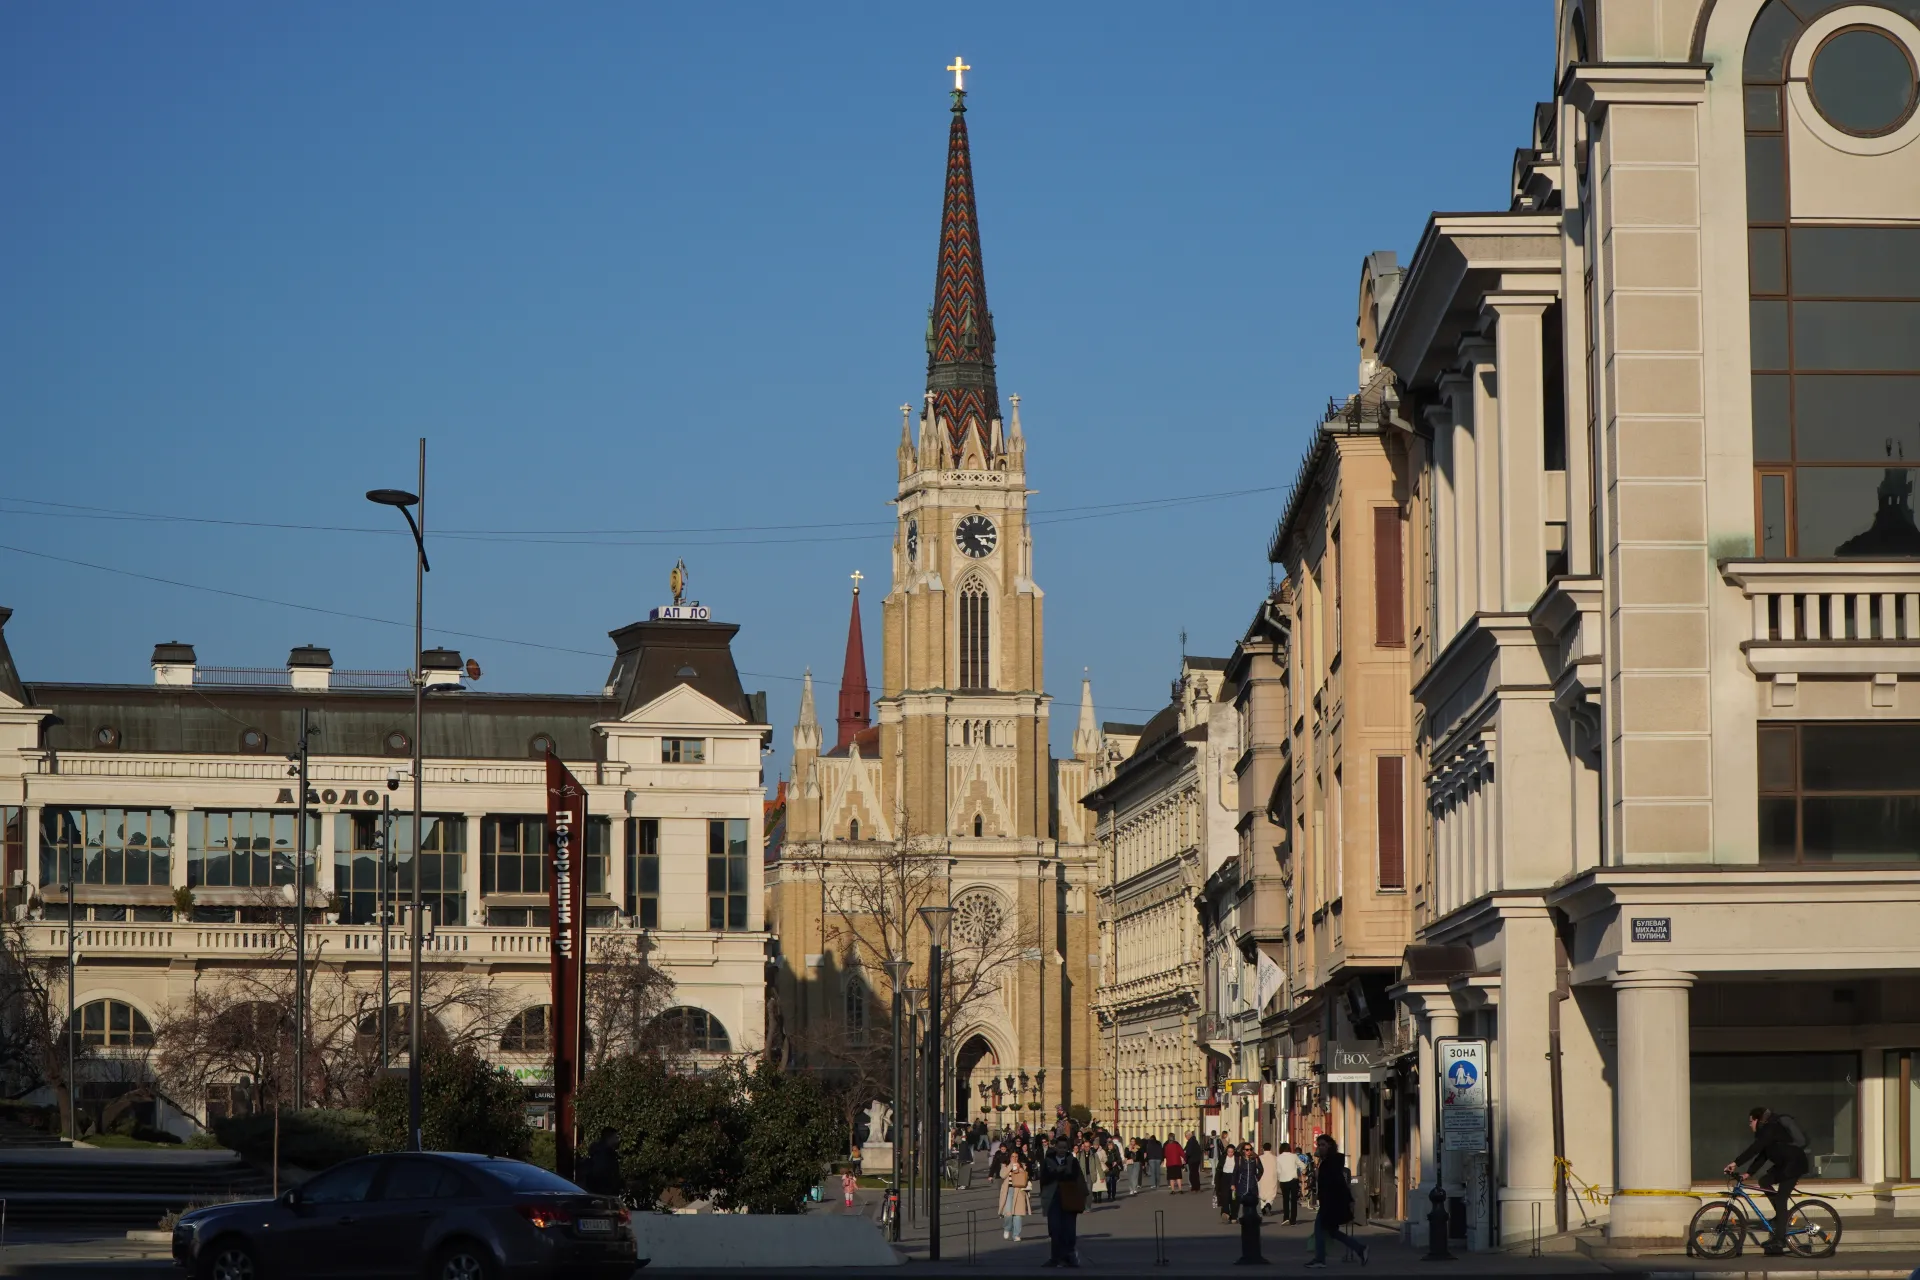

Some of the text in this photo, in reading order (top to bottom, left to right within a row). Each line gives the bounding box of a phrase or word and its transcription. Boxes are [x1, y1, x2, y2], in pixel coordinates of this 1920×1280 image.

[553, 810, 573, 959] Позоришни трг
[1450, 1048, 1476, 1058] ЗОНА
[1344, 1053, 1370, 1065] BOX
[1196, 1087, 1209, 1097] FLY
